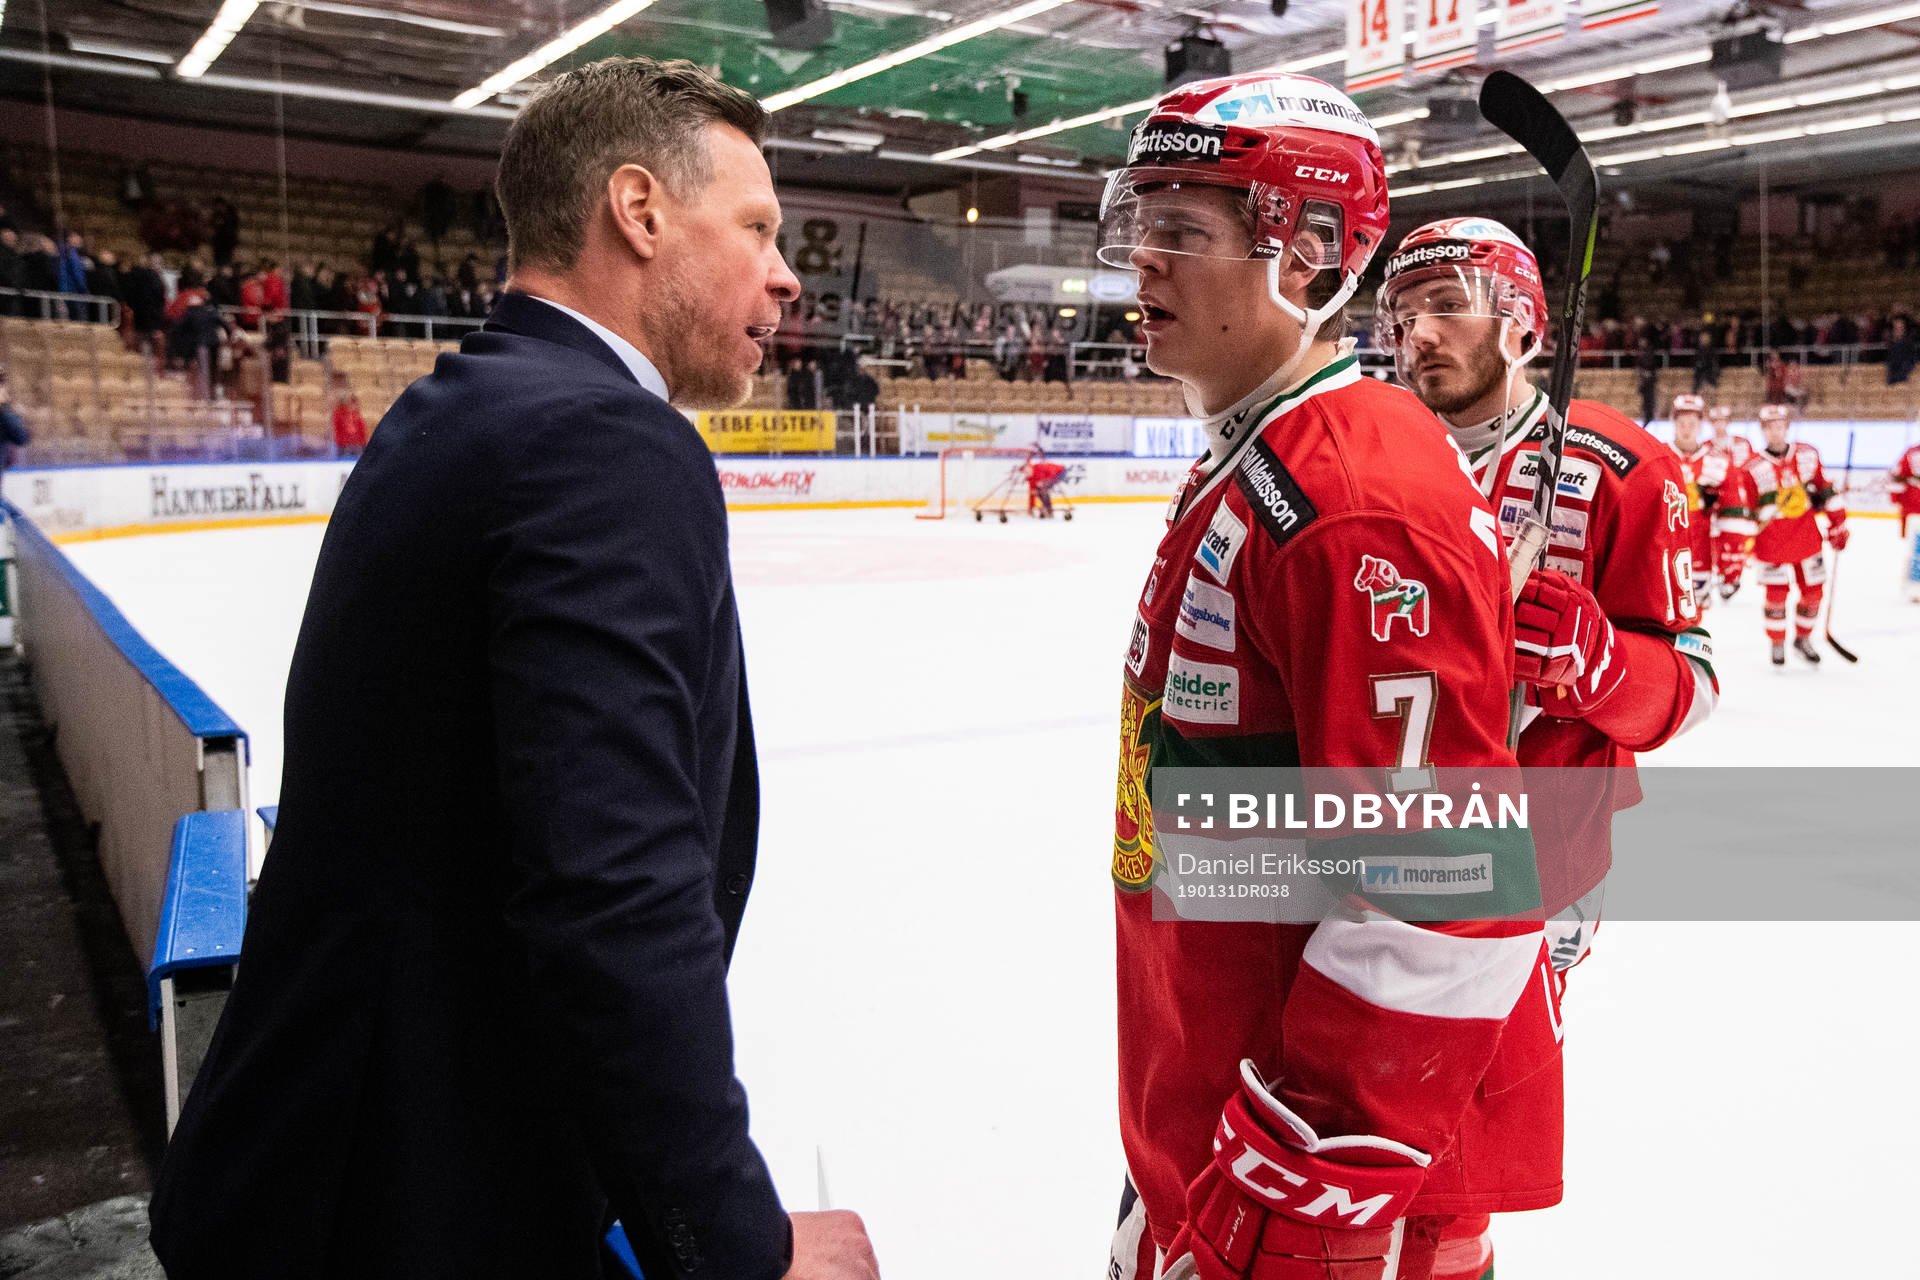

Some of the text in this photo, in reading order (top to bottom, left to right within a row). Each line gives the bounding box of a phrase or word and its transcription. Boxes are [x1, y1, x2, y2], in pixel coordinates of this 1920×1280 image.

[1294, 164, 1350, 184] CCM
[1256, 246, 1280, 256] CCM
[1392, 245, 1469, 272] Mattsson
[1519, 462, 1588, 487] daraft
[1245, 453, 1298, 532] Mattsson
[1662, 548, 1698, 624] 19
[1368, 671, 1439, 794] 7
[1403, 864, 1488, 884] moramast
